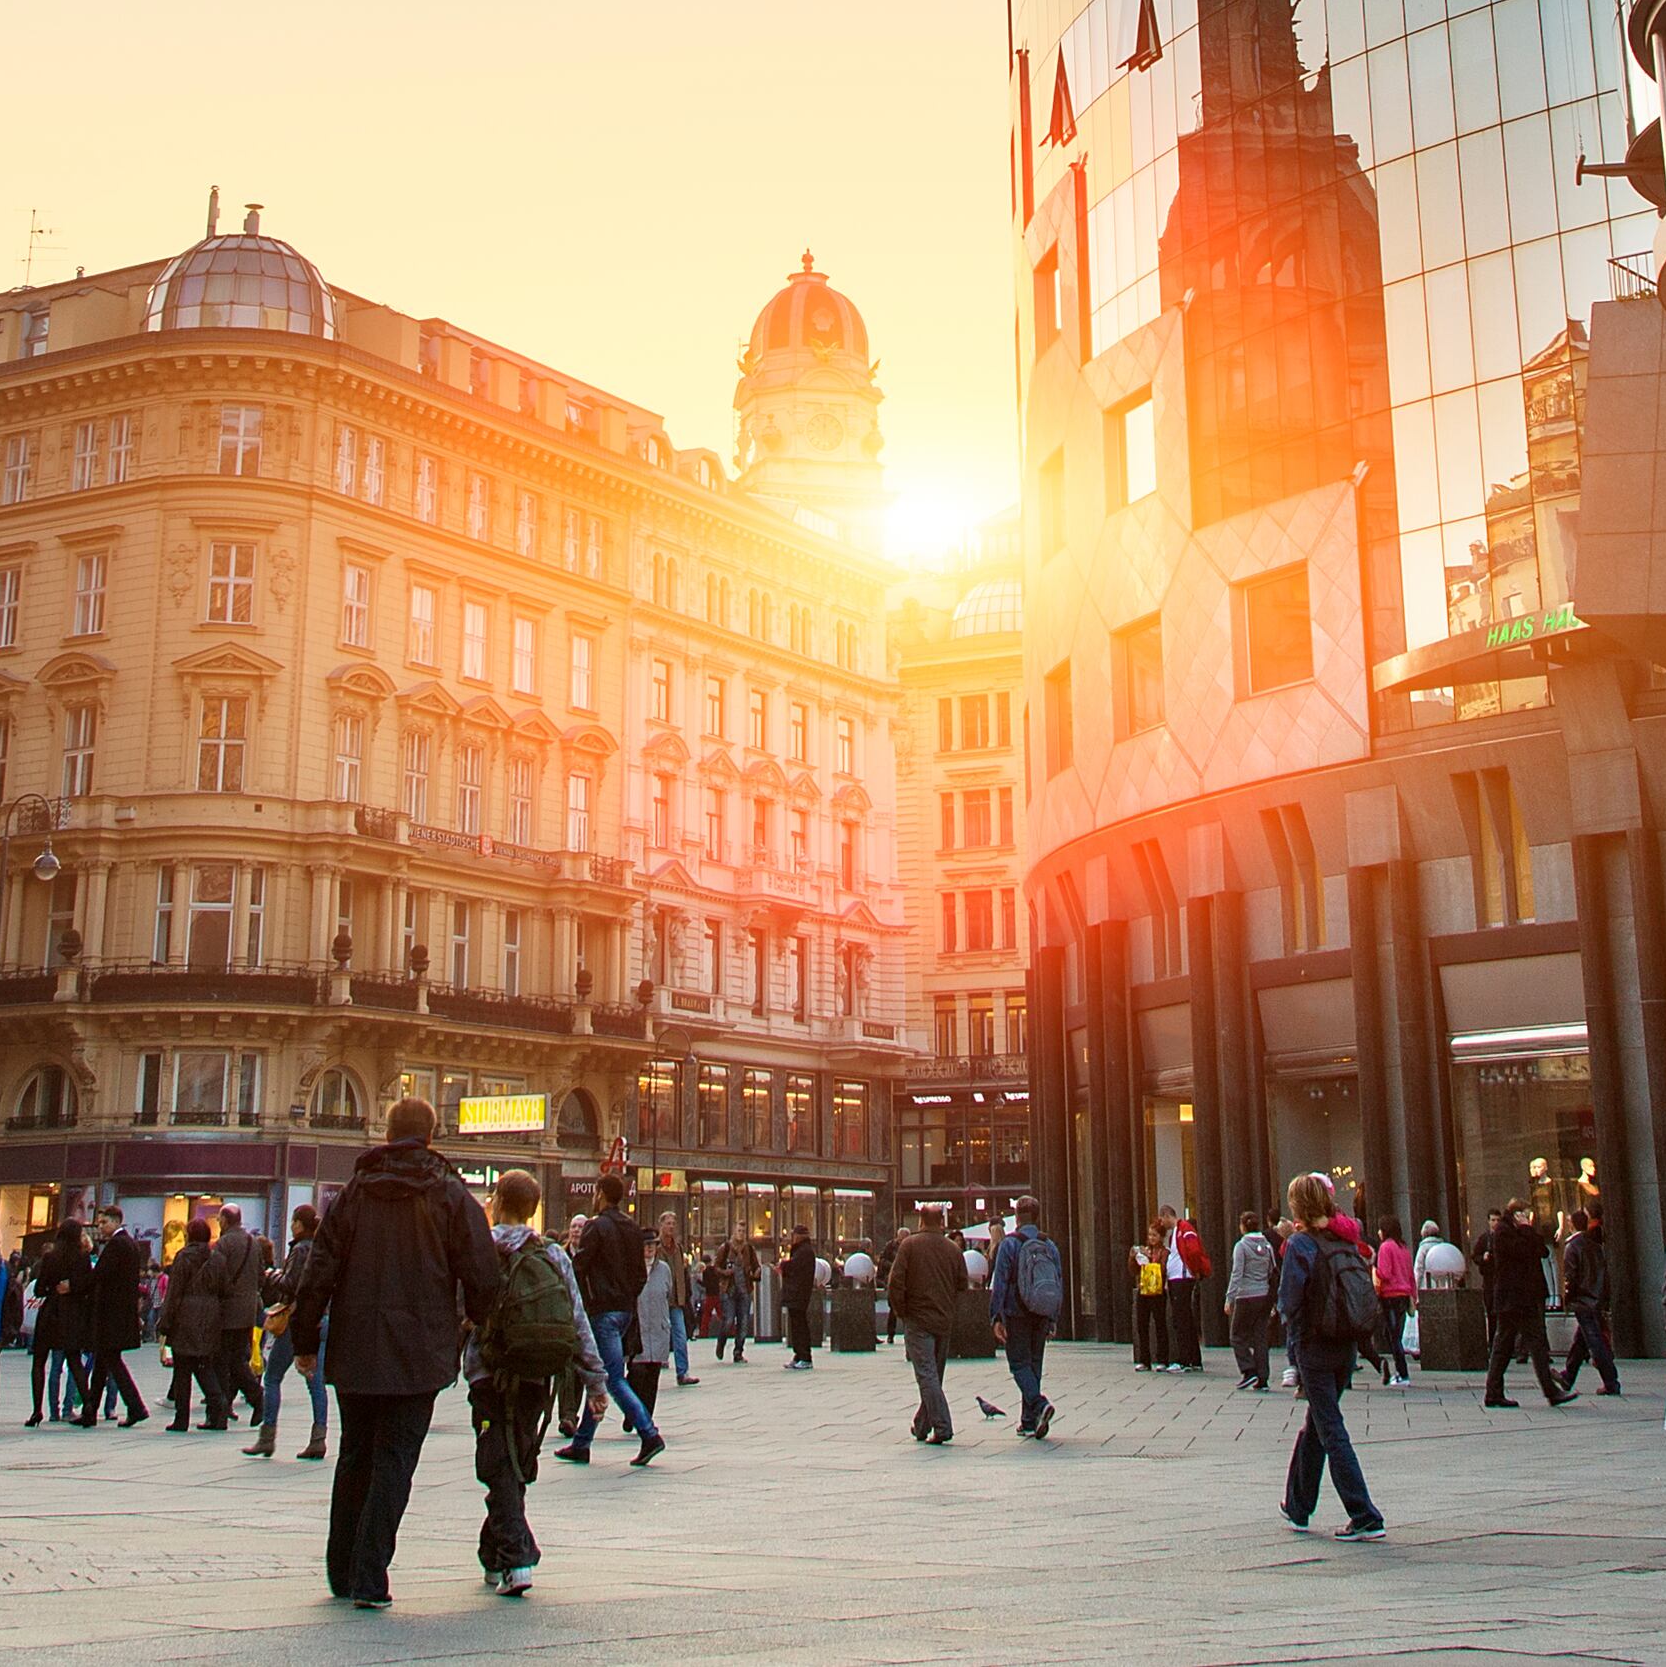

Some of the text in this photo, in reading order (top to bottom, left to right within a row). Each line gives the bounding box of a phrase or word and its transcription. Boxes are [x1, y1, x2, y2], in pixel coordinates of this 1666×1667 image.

[1486, 616, 1533, 649] HAAS
[464, 1098, 540, 1126] STURMAYR
[912, 1096, 952, 1105] NESPRESSO
